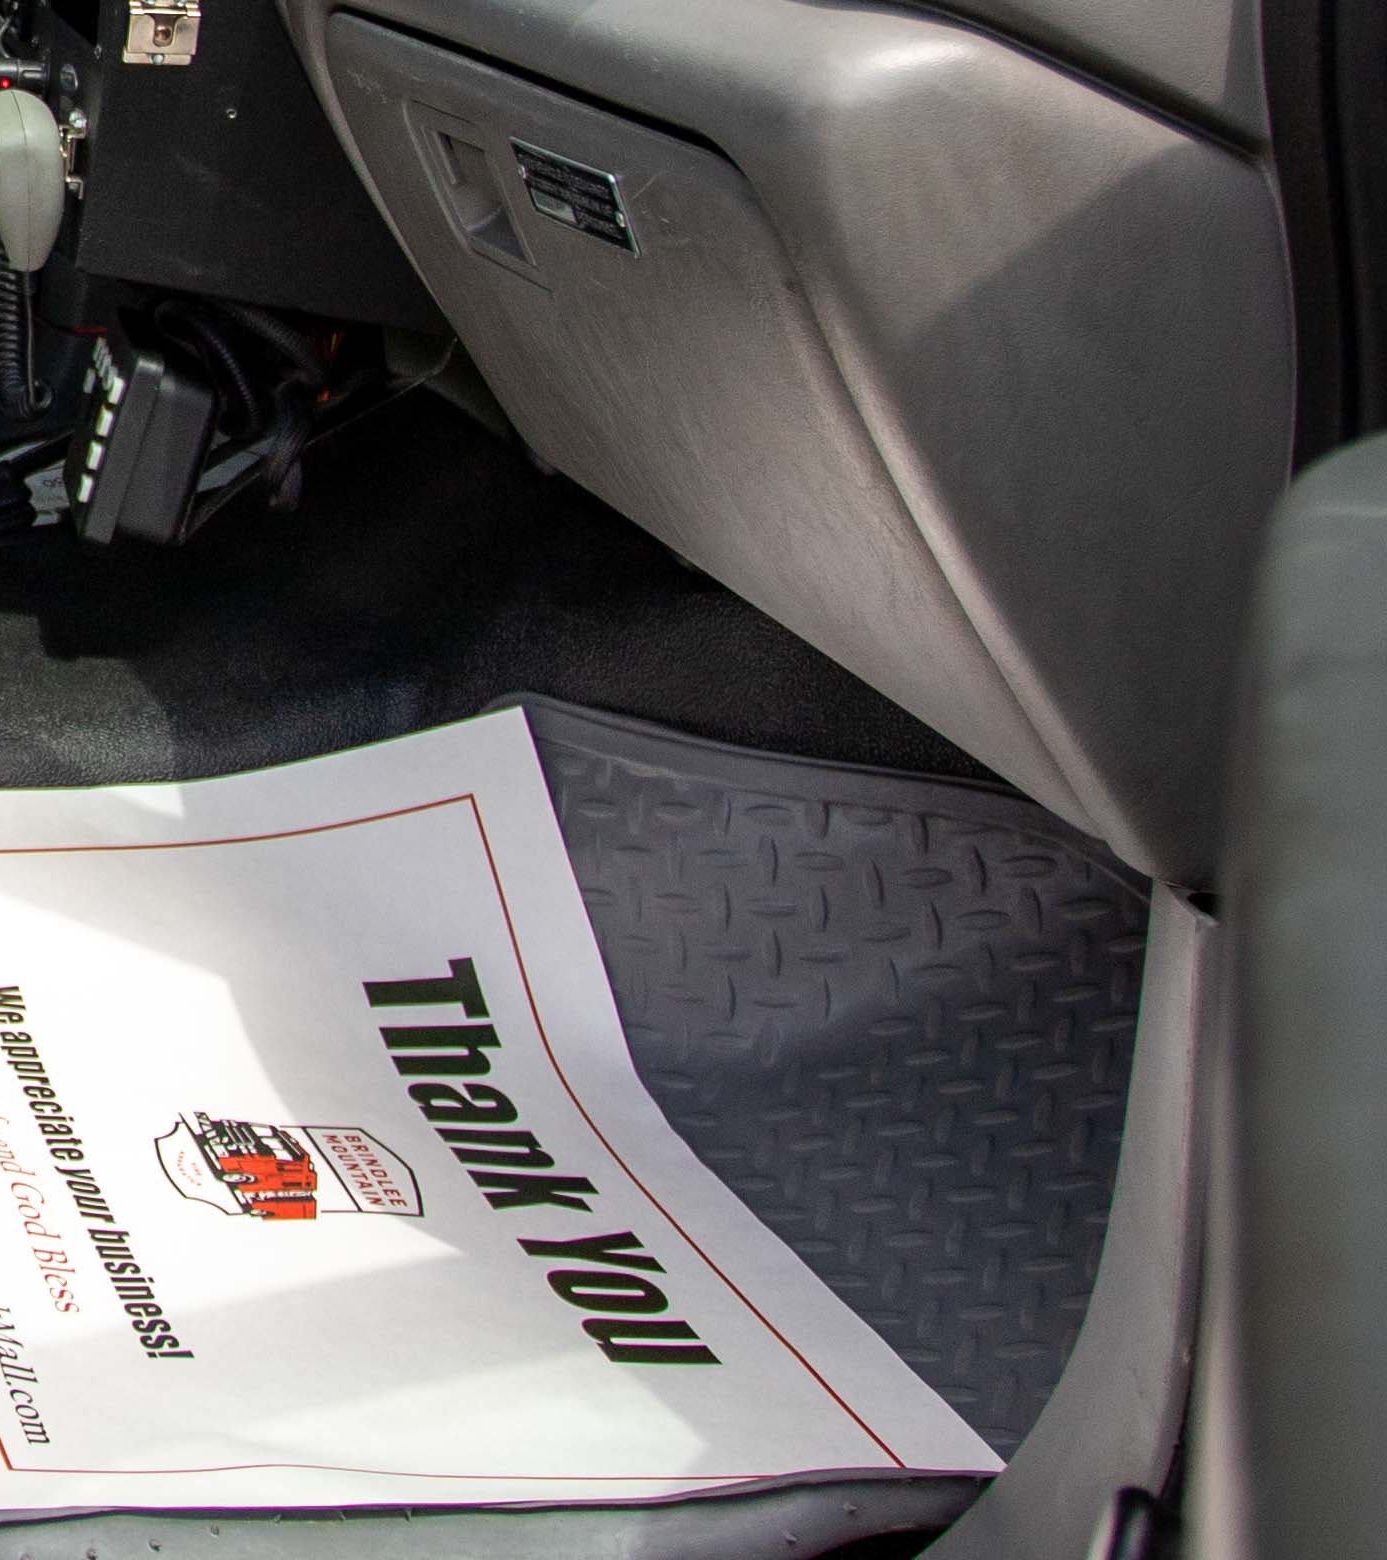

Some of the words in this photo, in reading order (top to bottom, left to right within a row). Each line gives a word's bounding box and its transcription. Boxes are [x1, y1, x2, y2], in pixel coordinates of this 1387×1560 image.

[0, 1031, 85, 1162] appreciate
[54, 1165, 116, 1224] your
[87, 1228, 195, 1360] business!
[322, 1134, 385, 1207] MOUNTAIN
[343, 1135, 407, 1208] BRINDLEE
[362, 957, 600, 1213] Thank
[516, 1231, 723, 1365] You
[11, 1182, 61, 1239] God
[32, 1246, 80, 1313] Bless
